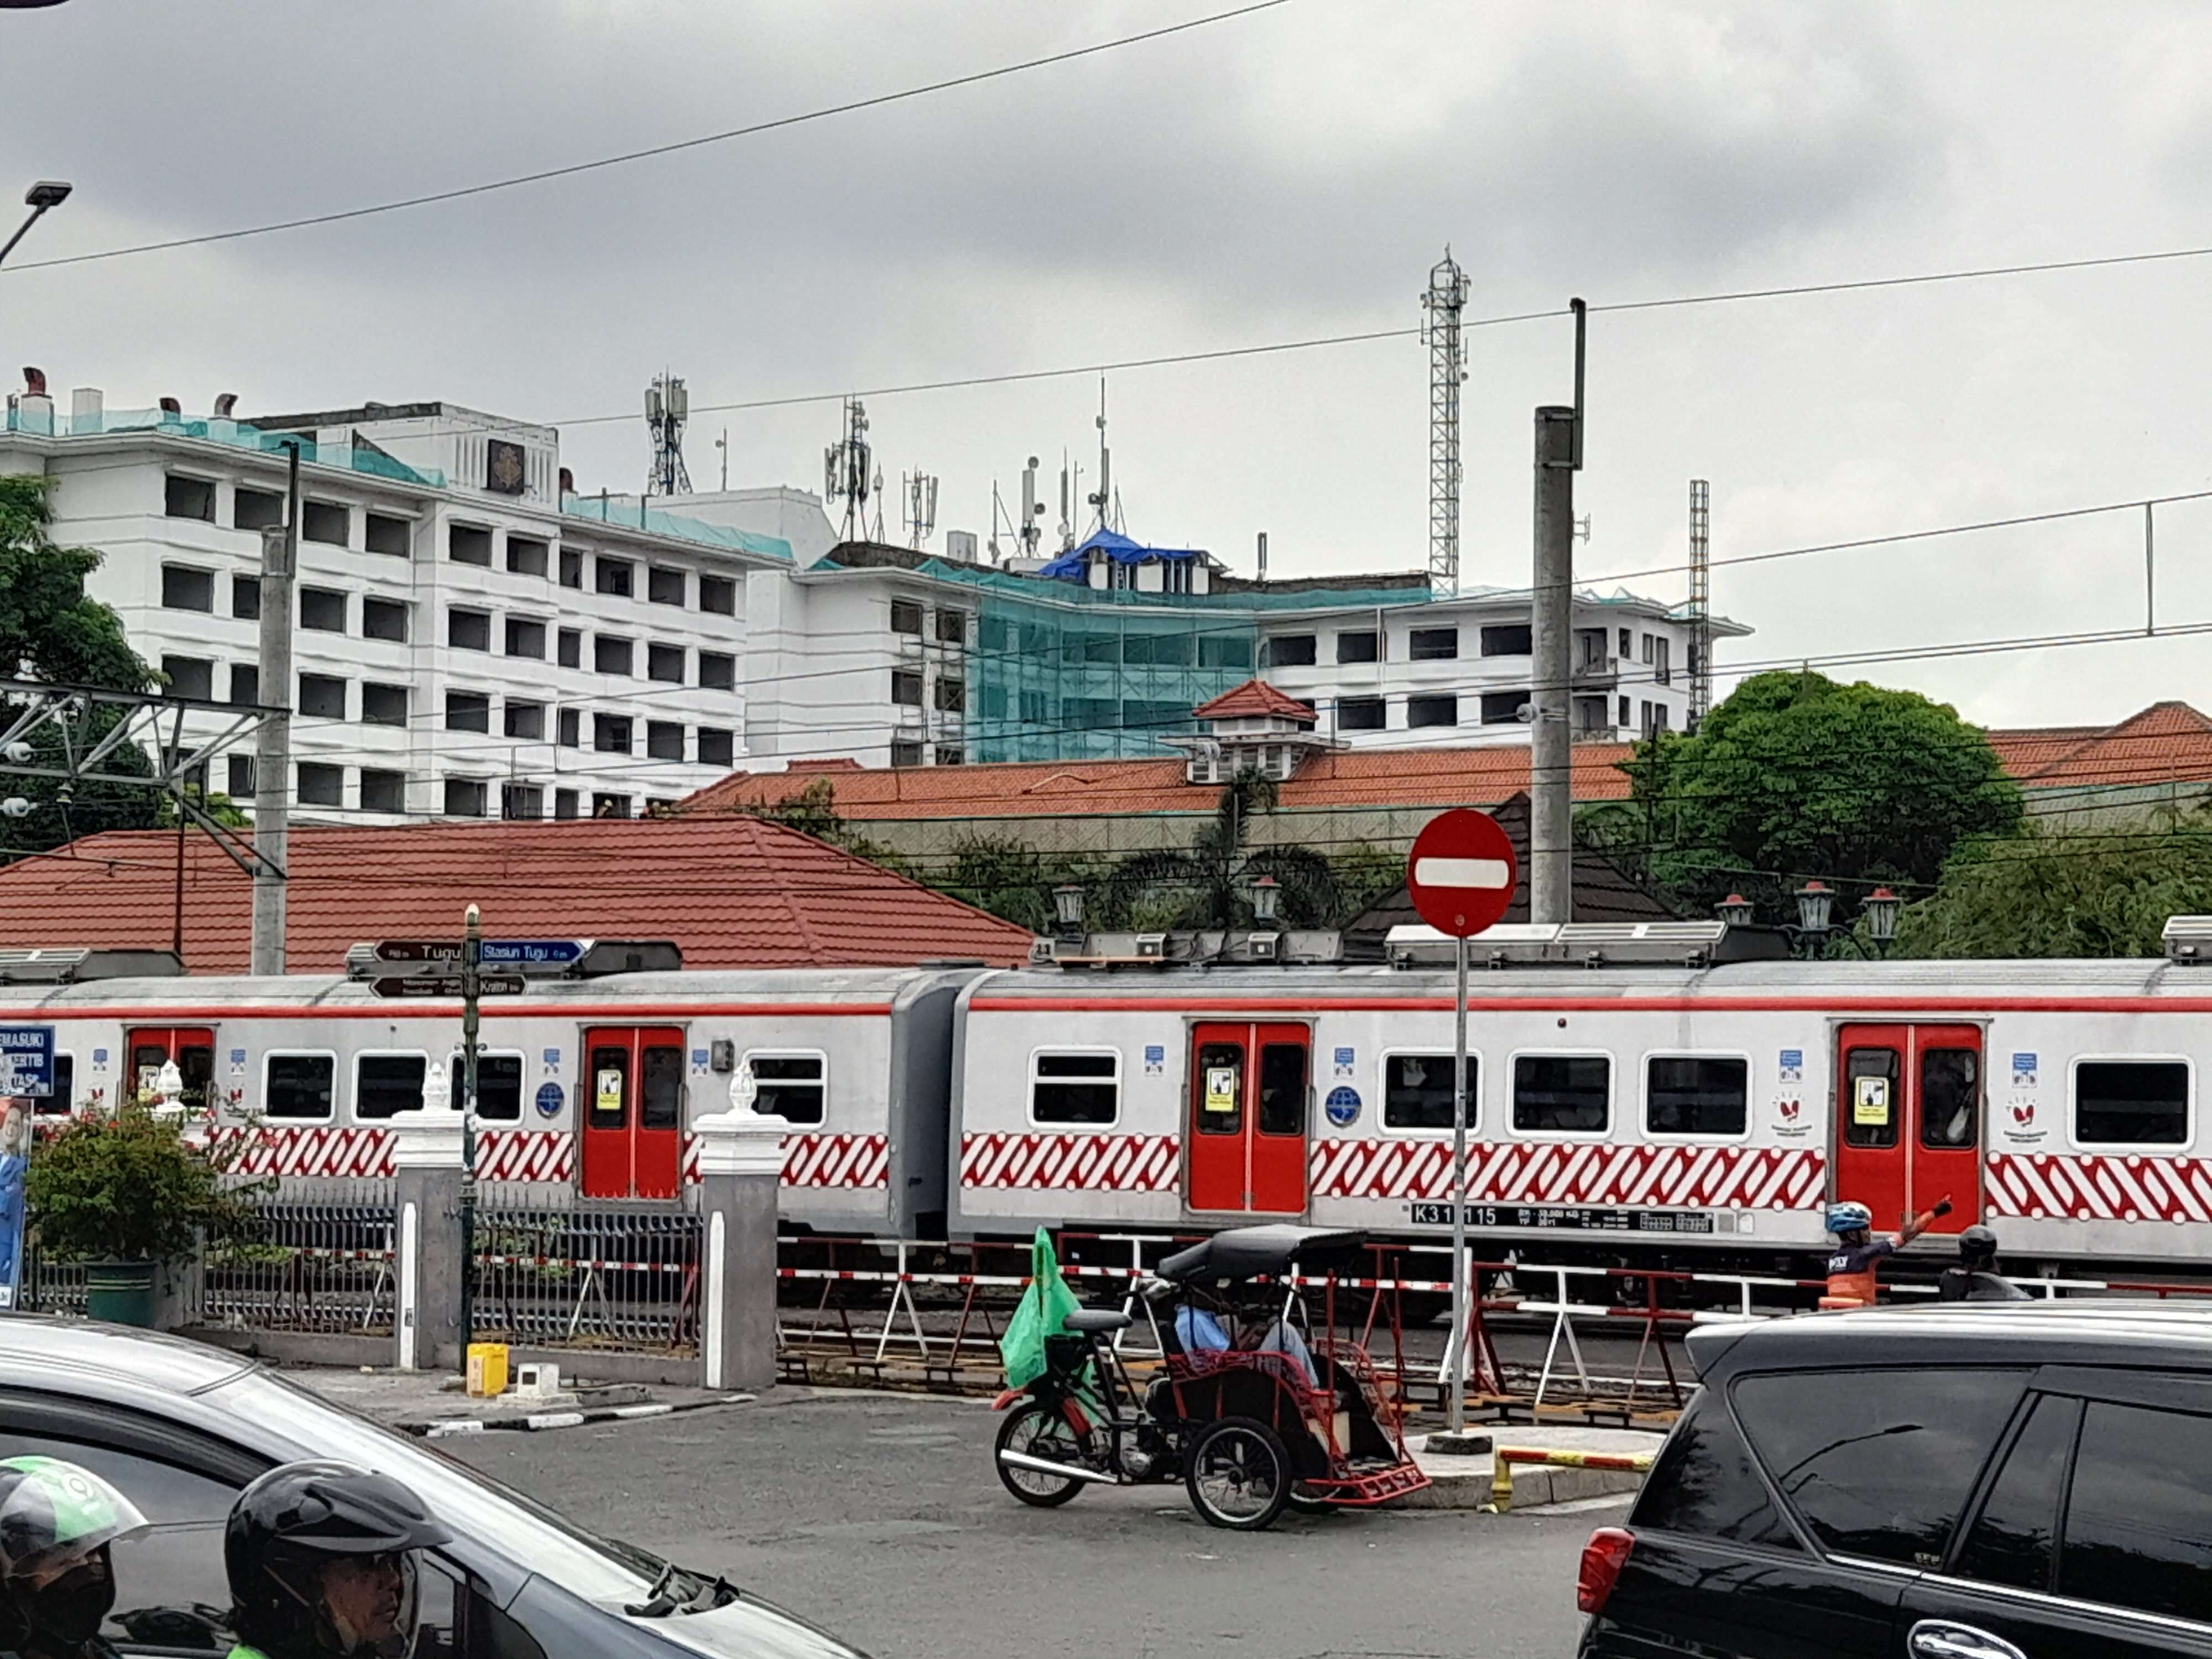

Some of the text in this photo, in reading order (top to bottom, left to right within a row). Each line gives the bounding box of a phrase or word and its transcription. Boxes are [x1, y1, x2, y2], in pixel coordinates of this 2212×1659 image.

[421, 945, 461, 961] Tugu
[484, 945, 521, 959] Stasiun
[524, 945, 549, 962] Tugu
